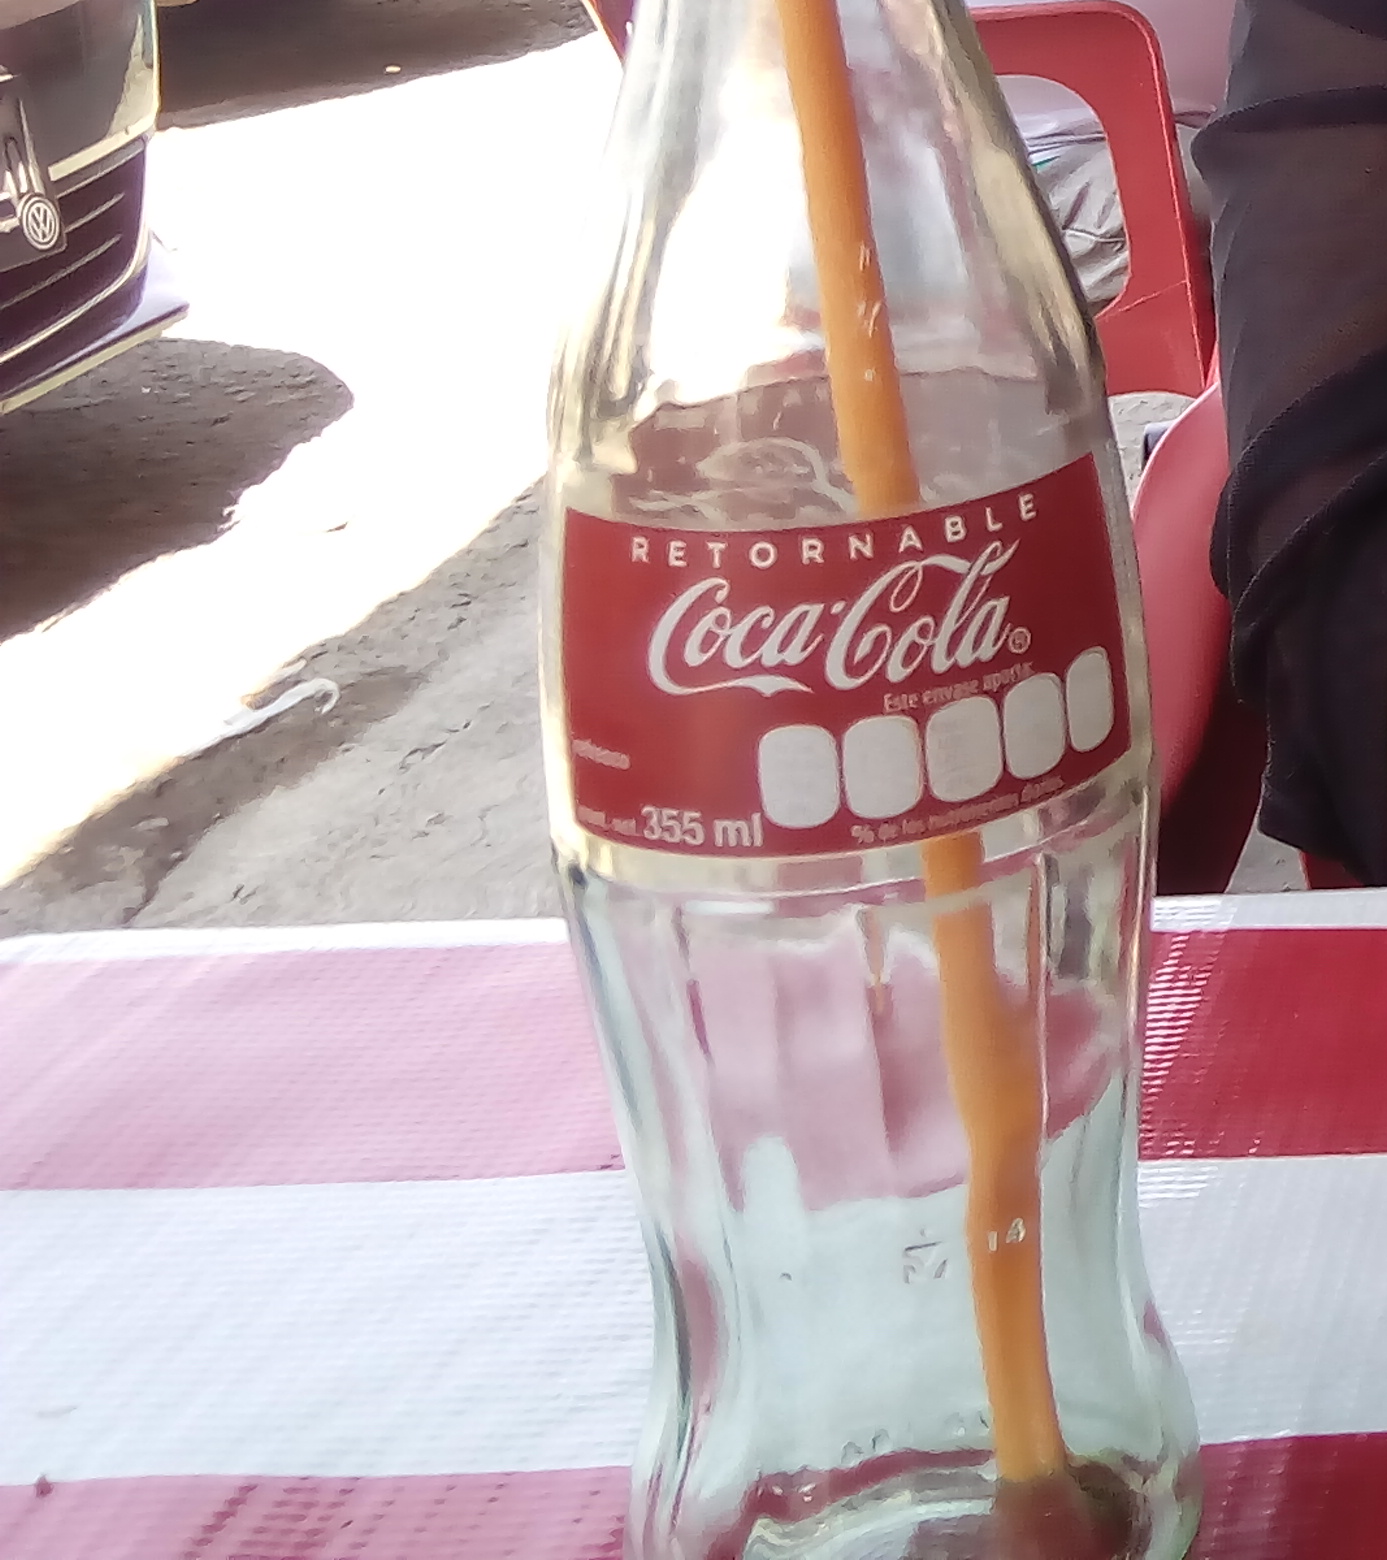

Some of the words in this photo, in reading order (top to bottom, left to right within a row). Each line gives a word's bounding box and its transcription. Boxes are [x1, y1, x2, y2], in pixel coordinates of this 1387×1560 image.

[631, 492, 1040, 569] RETORNABLE
[647, 538, 1020, 698] Coca-Cola
[641, 805, 705, 846] 355
[713, 812, 764, 847] ml
